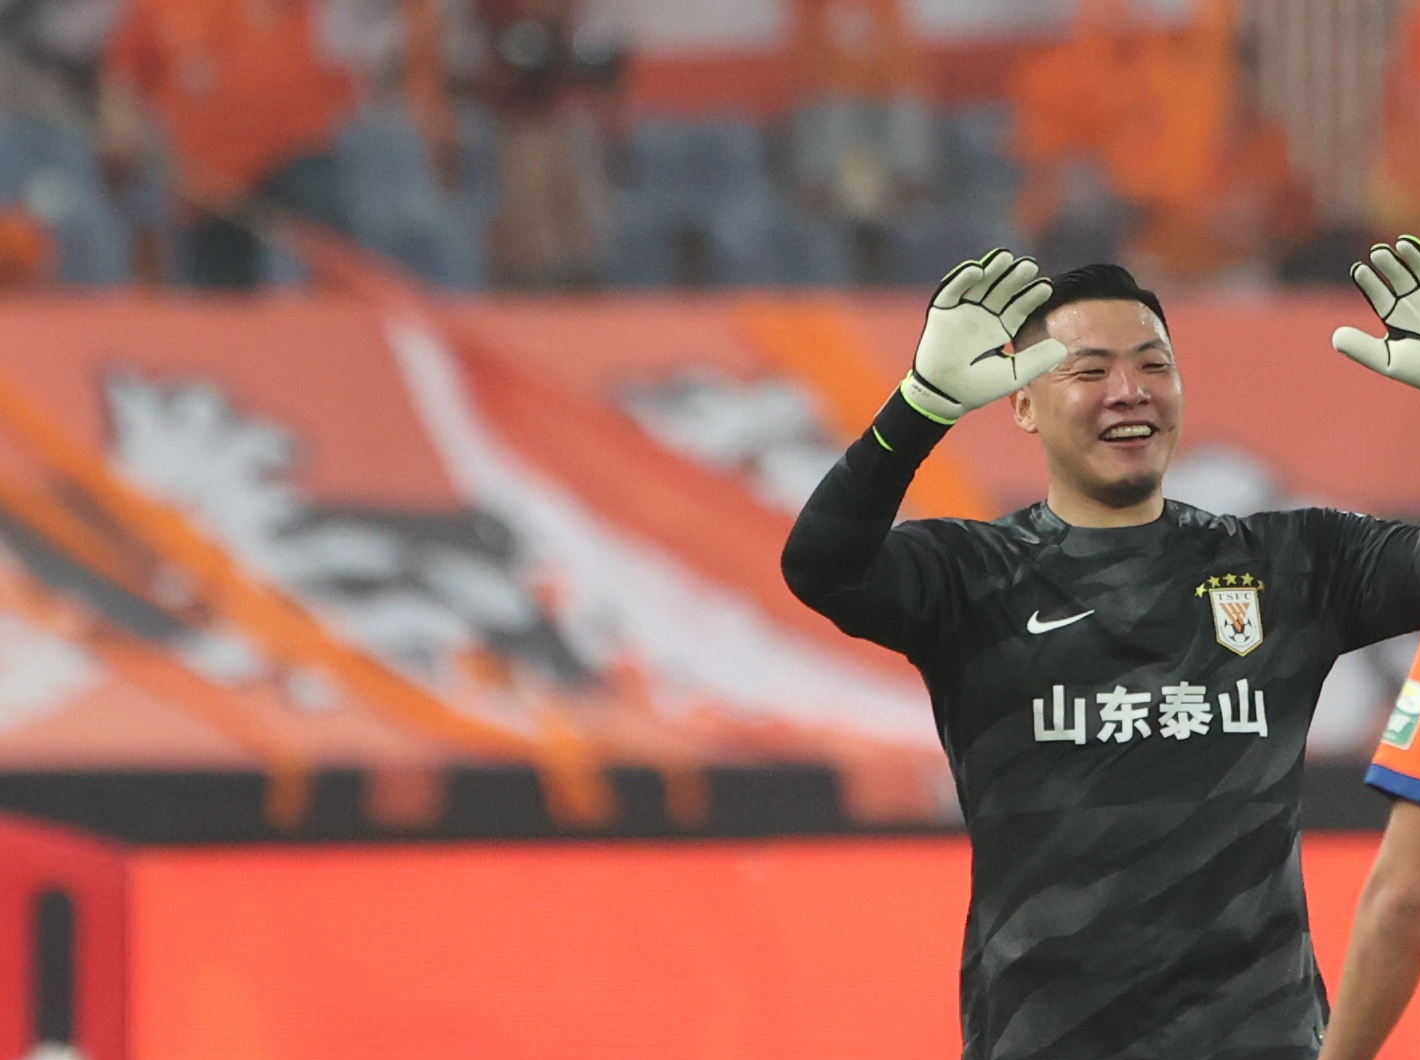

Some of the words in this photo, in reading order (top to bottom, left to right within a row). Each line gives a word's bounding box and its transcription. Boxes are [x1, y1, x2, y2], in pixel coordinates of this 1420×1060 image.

[1216, 592, 1252, 601] TSFC
[1032, 679, 1269, 745] 山东泰山
